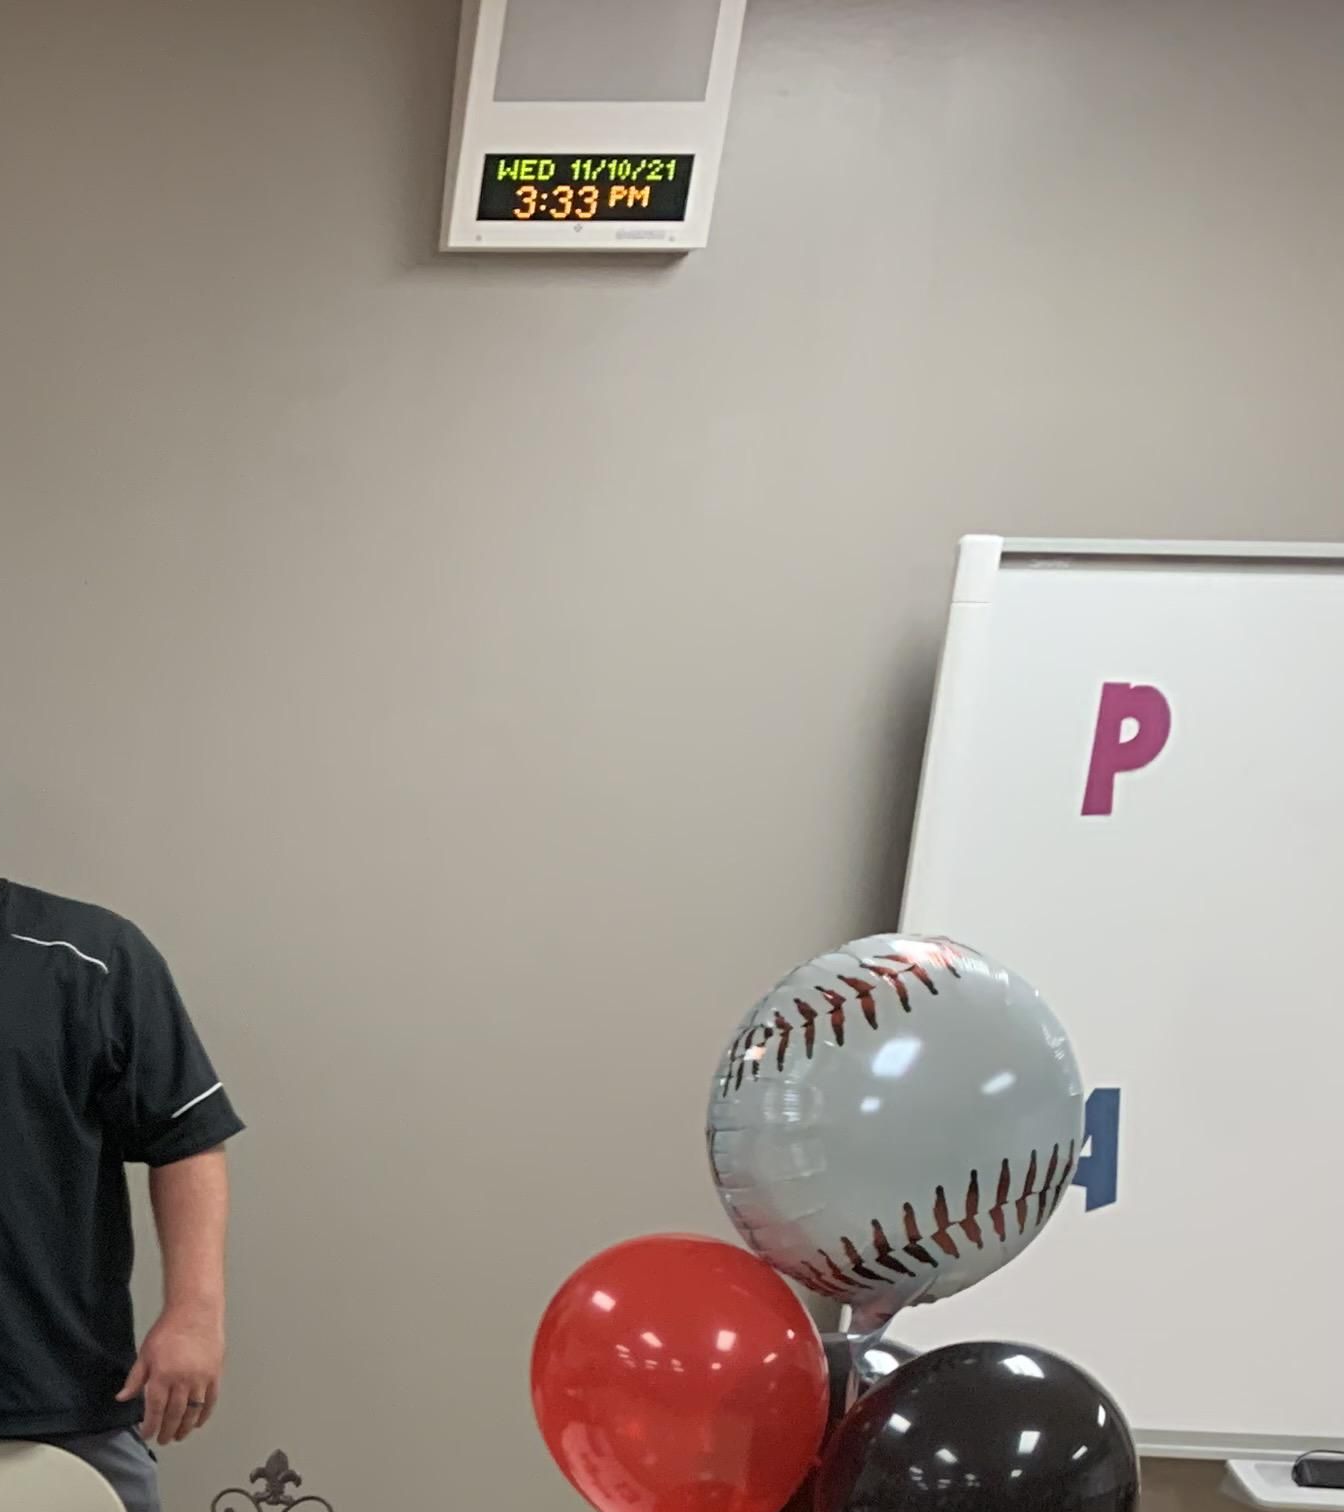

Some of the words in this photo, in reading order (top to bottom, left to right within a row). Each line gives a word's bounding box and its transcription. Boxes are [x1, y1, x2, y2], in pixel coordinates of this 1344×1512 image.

[496, 159, 556, 181] WED
[570, 159, 677, 181] 11/10/21
[514, 185, 600, 220] 3:33
[608, 185, 651, 209] PM
[1081, 682, 1172, 816] P
